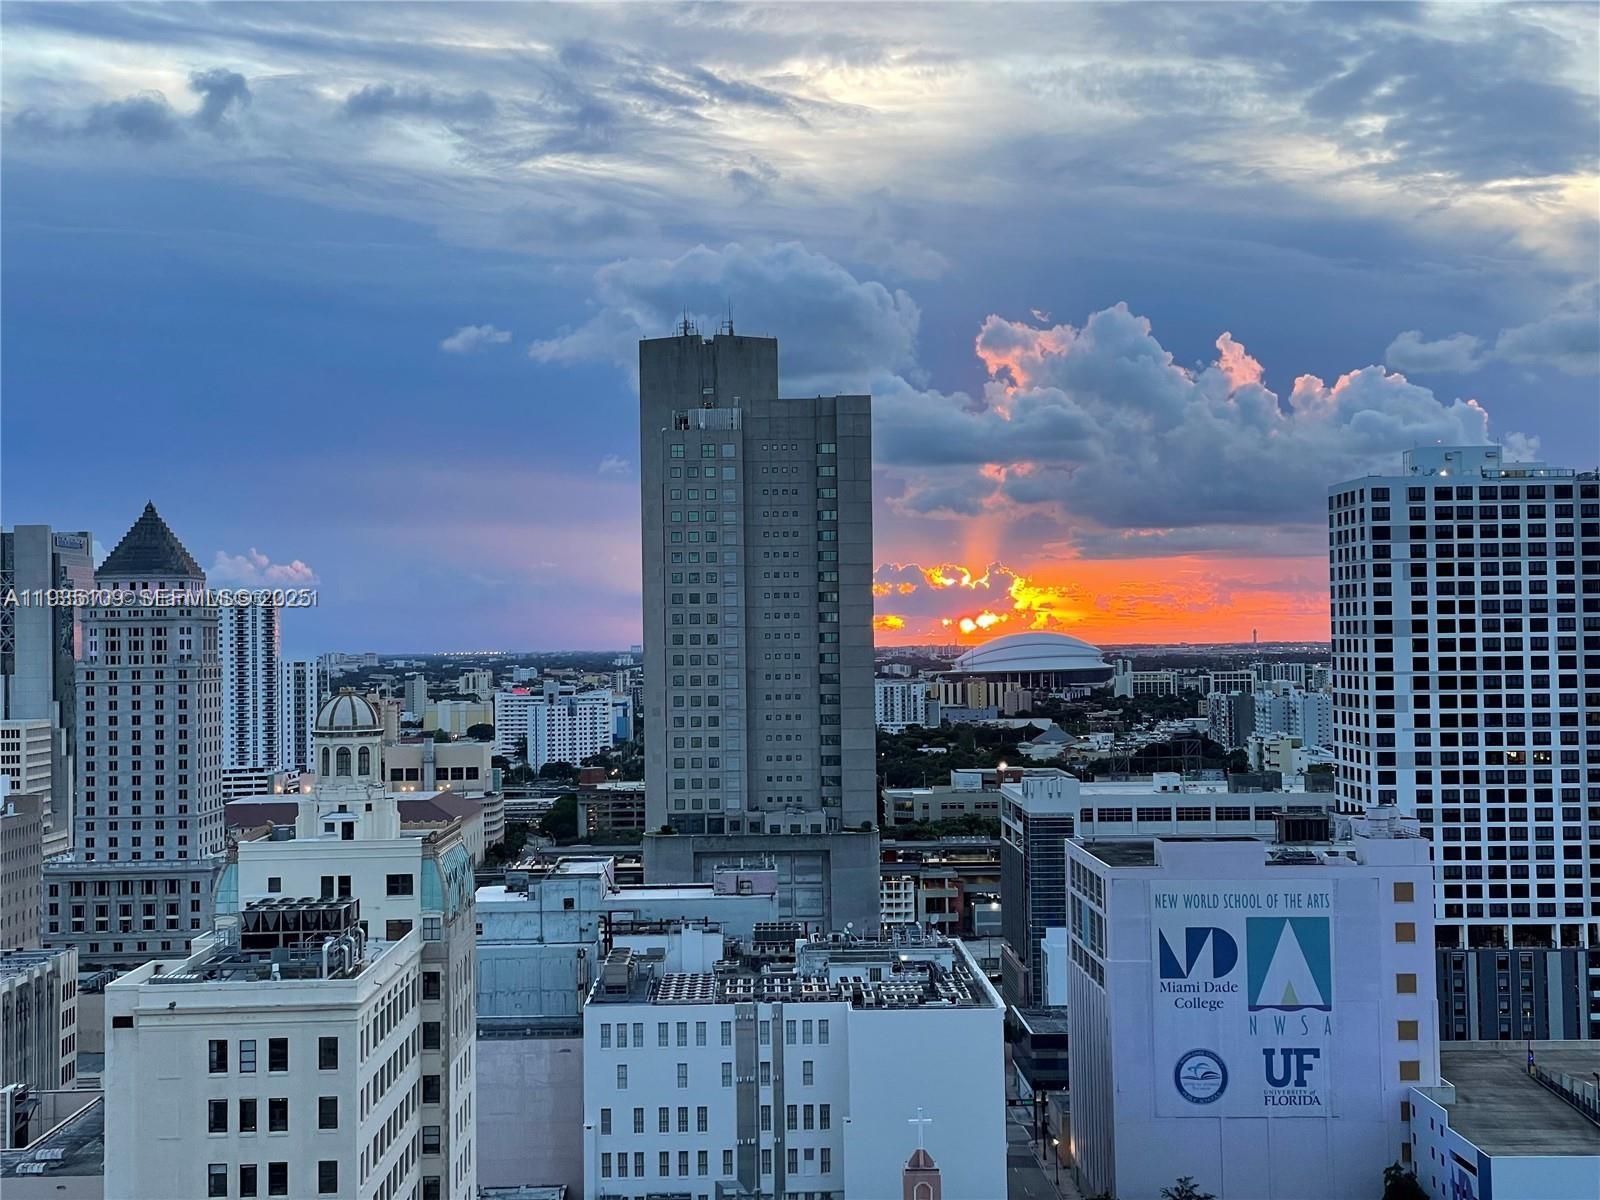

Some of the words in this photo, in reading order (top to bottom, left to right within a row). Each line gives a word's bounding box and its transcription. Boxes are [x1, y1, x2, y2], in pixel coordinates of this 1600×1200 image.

[1154, 894, 1178, 909] NEW
[1183, 894, 1219, 909] WORLD
[1223, 894, 1262, 909] SCHOOL
[1266, 893, 1279, 908] OF
[1284, 893, 1302, 908] THE
[1307, 893, 1330, 908] ARTS
[1159, 981, 1200, 993] Miami
[1204, 981, 1238, 993] Dade
[1174, 997, 1224, 1011] College
[1263, 1048, 1320, 1087] UF
[1264, 1095, 1321, 1106] FLORIDA
